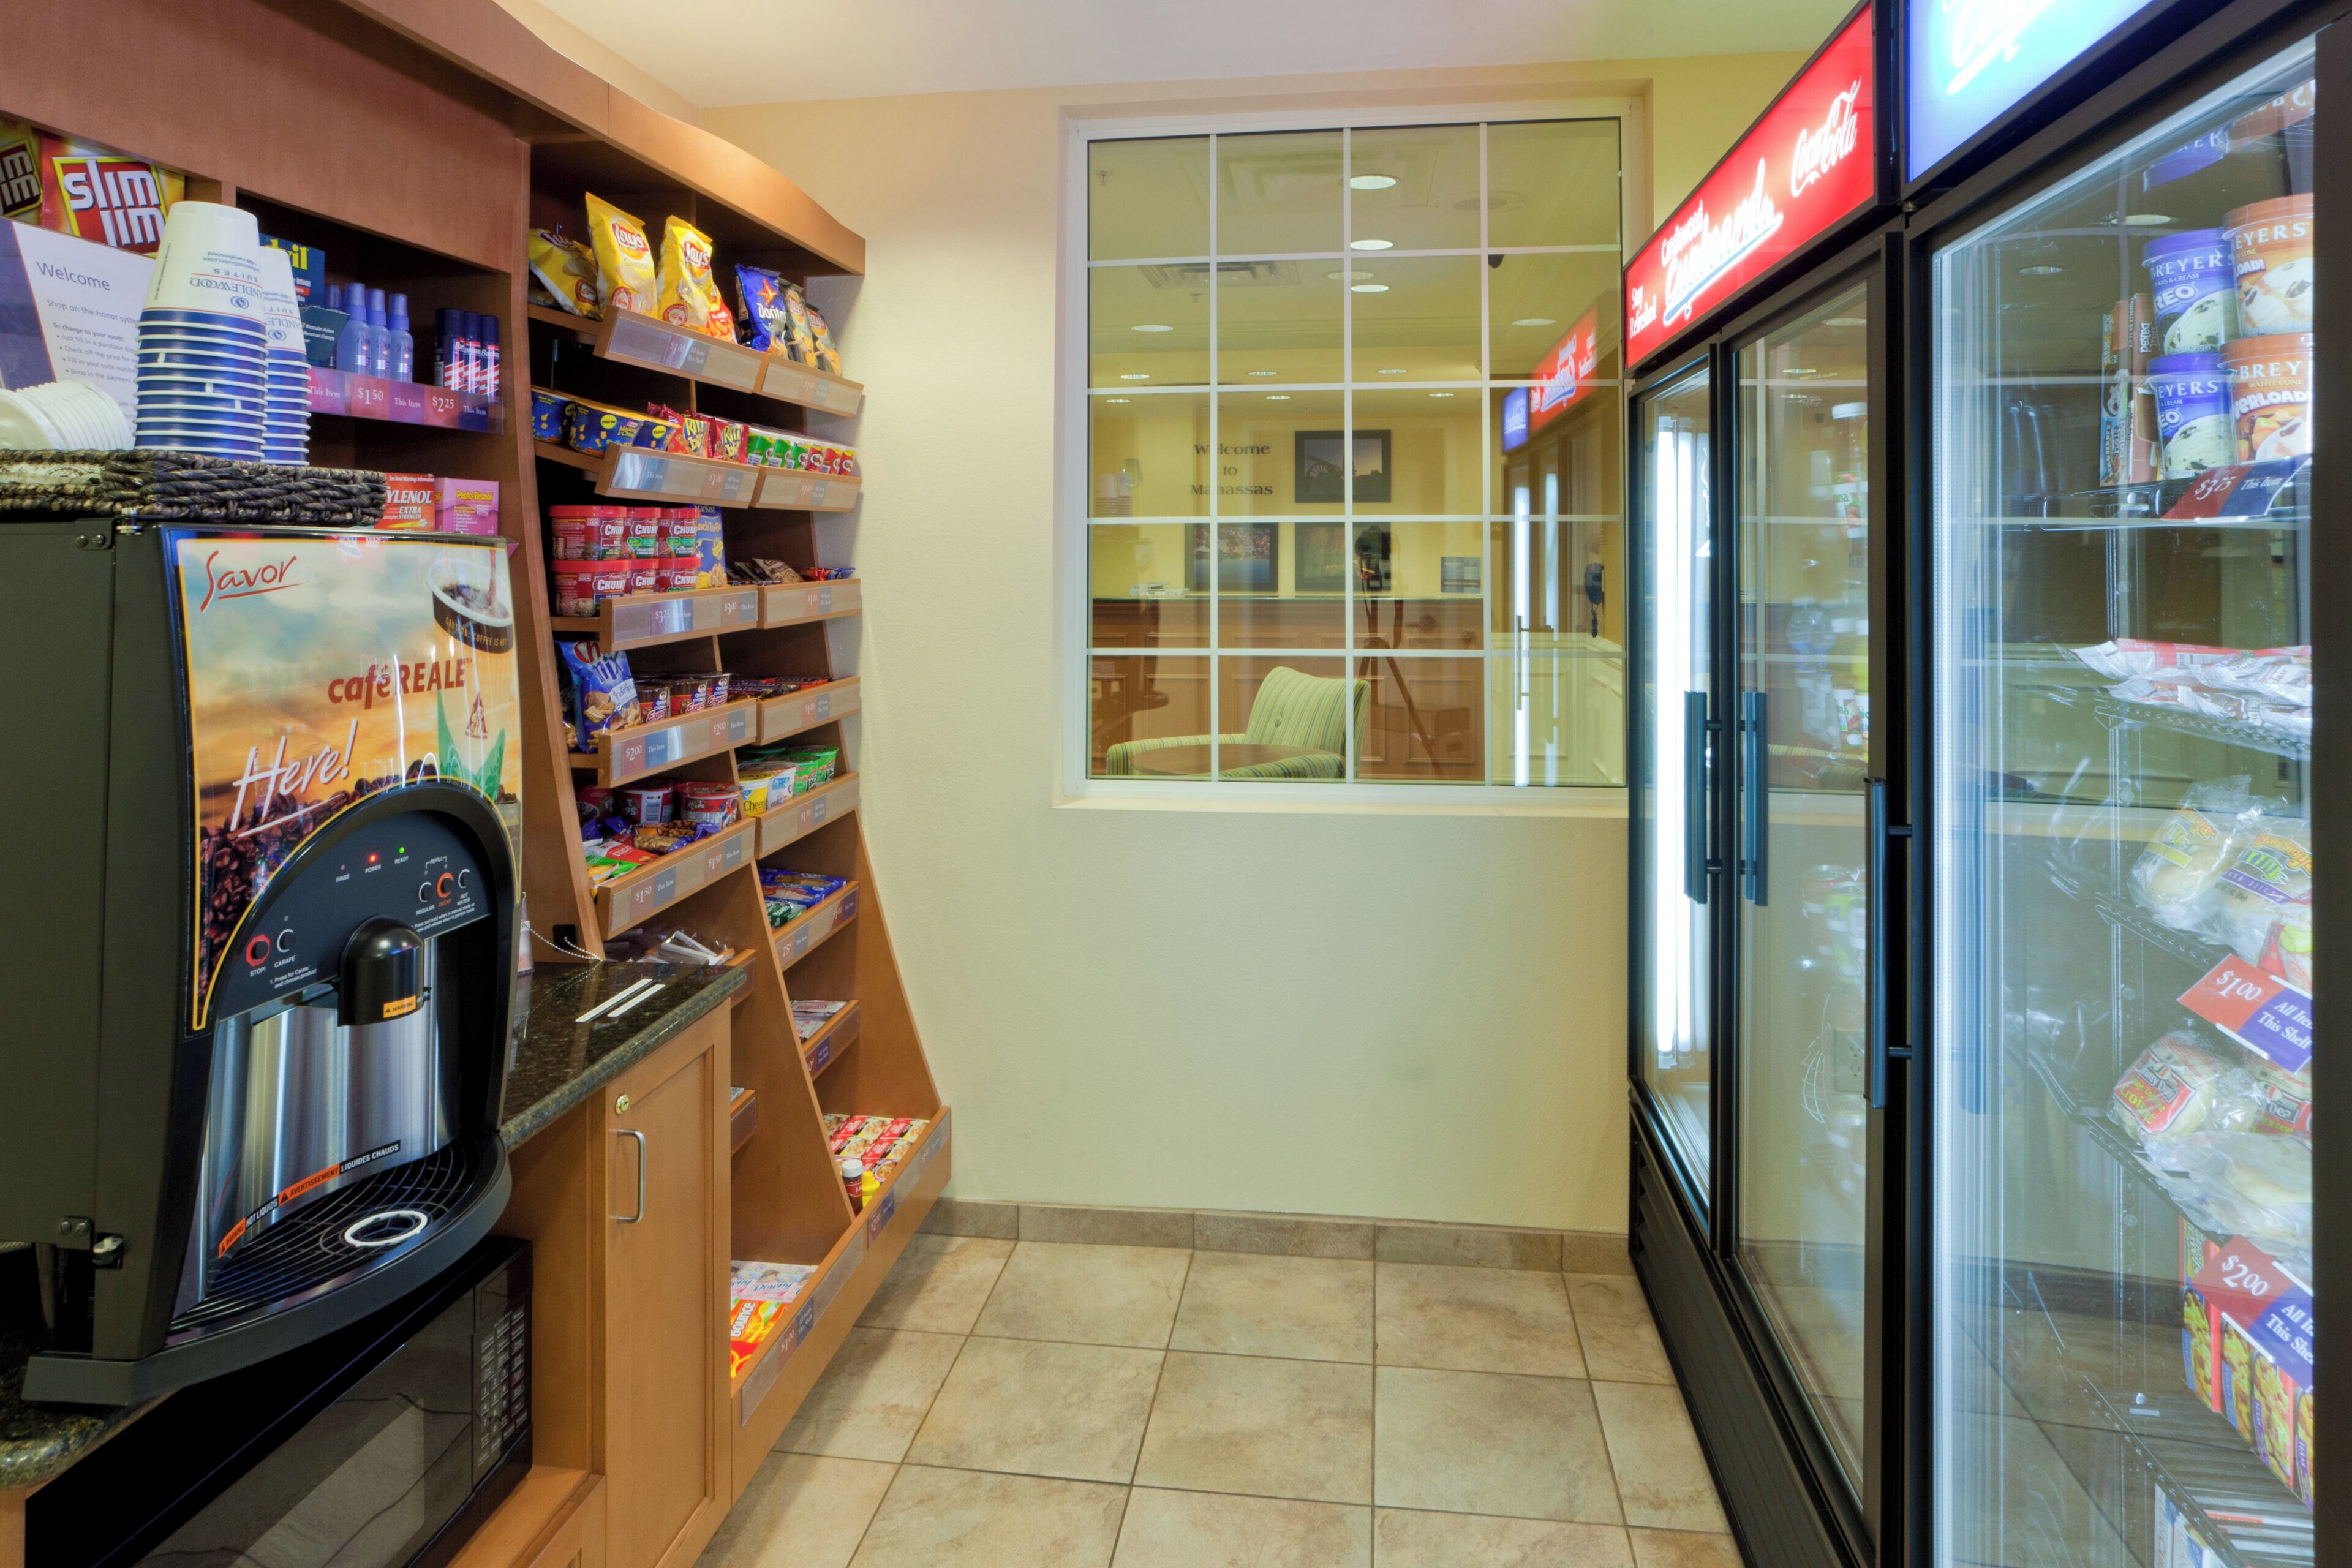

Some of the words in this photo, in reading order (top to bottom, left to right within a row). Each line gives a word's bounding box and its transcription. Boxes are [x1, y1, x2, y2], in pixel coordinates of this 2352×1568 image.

[1791, 75, 1861, 197] Coca-Cola
[36, 261, 111, 292] Welcome
[2154, 285, 2195, 309] REO
[47, 299, 67, 311] Shop
[81, 307, 95, 316] the
[96, 310, 118, 320] honor
[62, 325, 83, 334] charge
[308, 386, 326, 397] This
[326, 389, 341, 399] Item
[357, 388, 384, 405] $150
[2158, 380, 2219, 399] EYERS
[393, 398, 407, 407] This
[407, 399, 421, 409] Item
[432, 395, 454, 412] $225
[463, 405, 475, 414] This
[475, 407, 487, 415] Item
[1194, 443, 1271, 455] Wlcome
[1223, 466, 1238, 475] to
[2195, 476, 2237, 500] $375
[2241, 478, 2259, 490] This
[386, 489, 433, 505] YLENOL
[456, 490, 493, 501] Pepto-Bismol
[399, 505, 421, 514] EXTRA
[200, 550, 298, 613] Savor
[626, 744, 643, 761] $200
[230, 718, 359, 832] Here!
[364, 864, 382, 873] POWER
[394, 856, 409, 865] READY
[336, 873, 350, 883] RINSE
[635, 886, 652, 903] $150
[416, 905, 435, 916] REGULAR
[274, 955, 296, 968] CARAFE
[249, 965, 266, 977] STOP!
[300, 968, 317, 980] product
[2215, 970, 2263, 1002] $100
[2274, 1001, 2296, 1018] All
[2258, 1011, 2283, 1034] This
[341, 1153, 371, 1172] LIQUIDES
[371, 1143, 400, 1160] CHAUDS
[257, 1198, 278, 1220] LIQUIDS
[2222, 1254, 2269, 1297] $200
[753, 1282, 794, 1292] Downy
[2281, 1303, 2302, 1324] All
[2266, 1314, 2292, 1341] This
